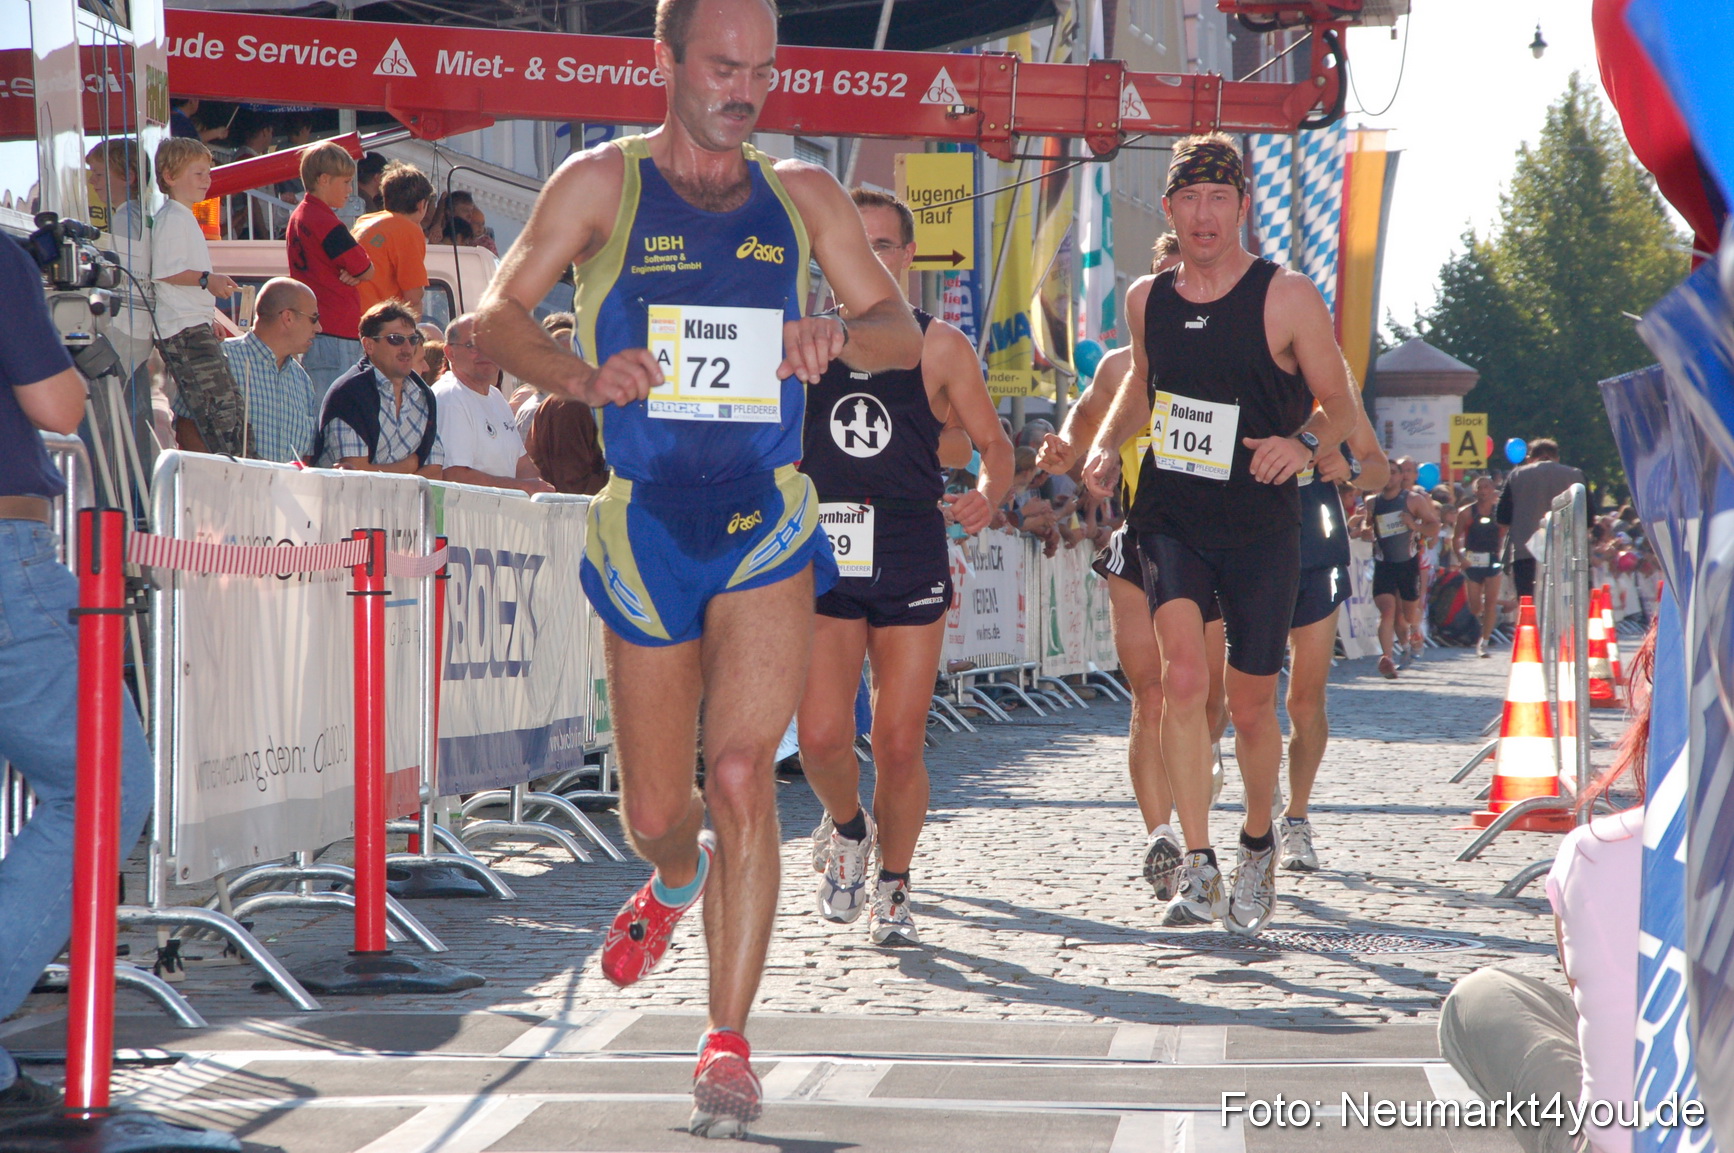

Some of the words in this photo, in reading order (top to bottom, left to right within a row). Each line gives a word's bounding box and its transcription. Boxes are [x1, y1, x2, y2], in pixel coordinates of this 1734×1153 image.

[235, 34, 358, 68] Service
[435, 49, 515, 79] Miet-
[524, 57, 546, 80] &
[555, 57, 668, 87] Service
[833, 70, 908, 98] 6352
[920, 207, 953, 225] lauf
[644, 235, 684, 252] UBH
[644, 254, 678, 264] Software
[679, 253, 686, 262] &
[631, 263, 676, 275] Engineering
[677, 262, 702, 271] GmbH
[684, 319, 738, 340] Klaus
[657, 348, 671, 366] A
[687, 356, 731, 389] 72
[733, 404, 778, 415] PFLEIDERER
[1170, 403, 1213, 424] Roland
[1154, 420, 1162, 432] A
[1454, 415, 1484, 426] Block
[1169, 428, 1213, 455] 104
[1457, 430, 1479, 456] A
[1195, 463, 1229, 476] PFLEIDERER
